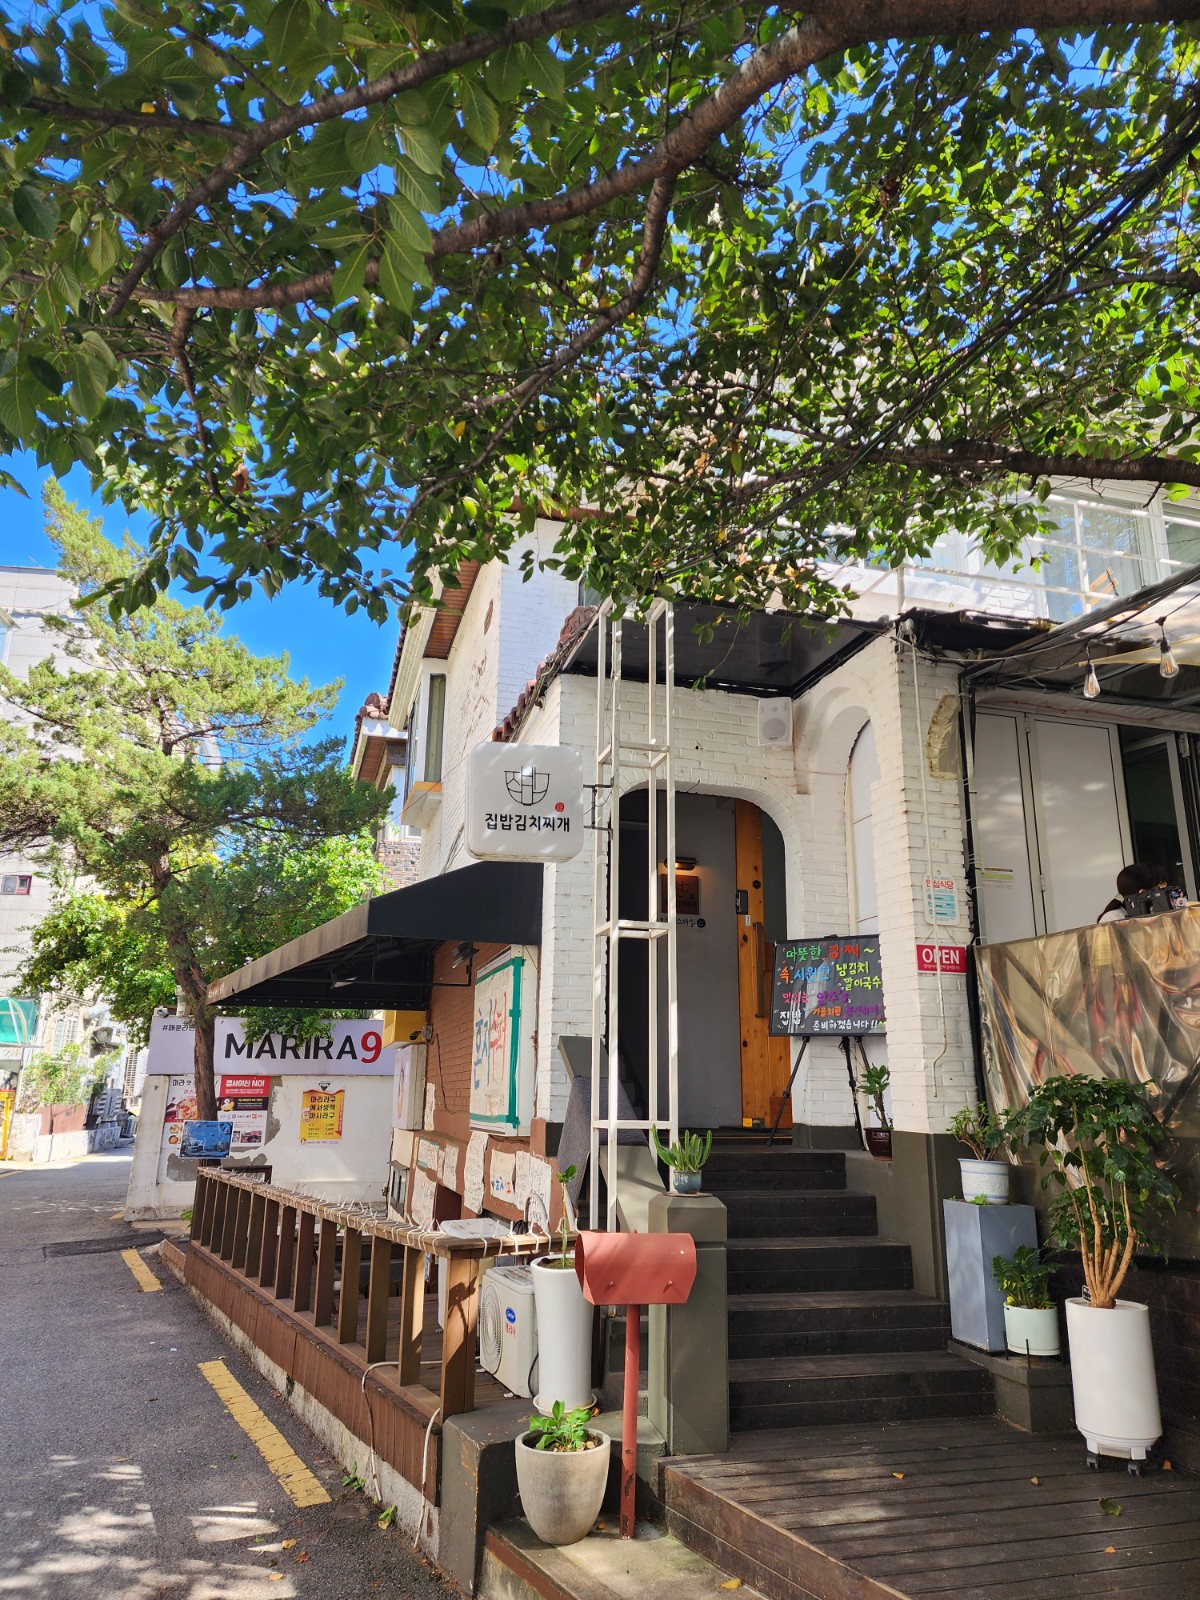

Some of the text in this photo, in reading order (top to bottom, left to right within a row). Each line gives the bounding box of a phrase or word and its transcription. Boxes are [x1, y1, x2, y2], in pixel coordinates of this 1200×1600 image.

[485, 813, 570, 832] 집밥김치찌개
[786, 945, 822, 962] 따뜻한
[922, 948, 960, 964] OPEN
[780, 961, 869, 985] 속 시원한 냉김치
[843, 975, 882, 991] 말이국수
[782, 992, 809, 1004] 맛있는
[780, 1010, 802, 1025] 집밥
[813, 1006, 842, 1018] 가을처럼
[224, 1031, 383, 1063] MARIRA9
